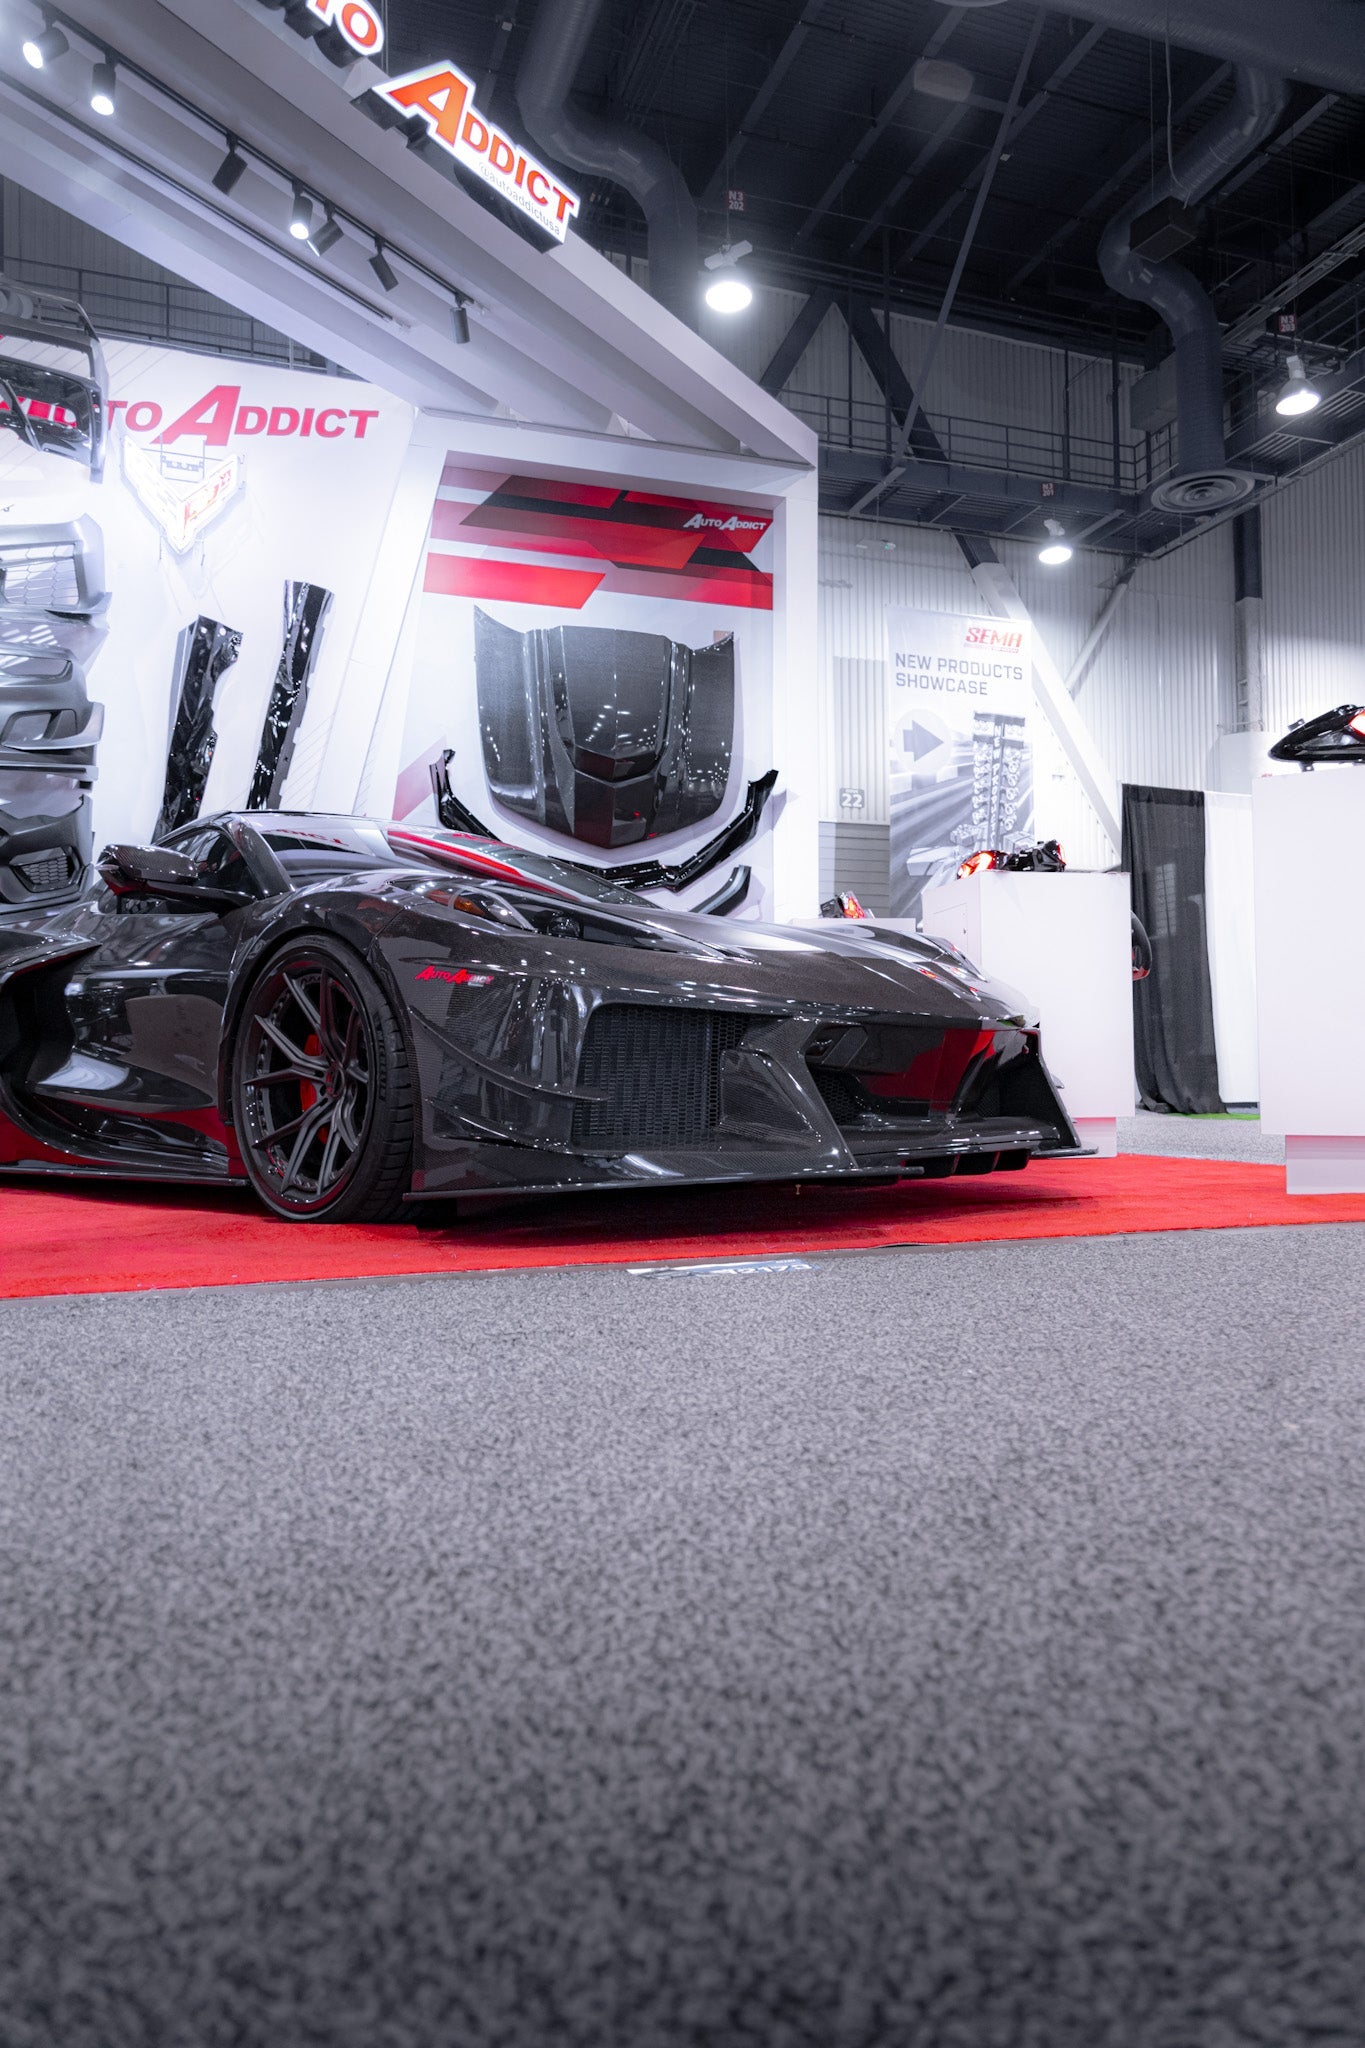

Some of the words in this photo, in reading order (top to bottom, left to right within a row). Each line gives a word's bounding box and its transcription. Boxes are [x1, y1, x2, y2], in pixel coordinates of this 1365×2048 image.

[479, 162, 560, 235] @autoaddictusa
[728, 190, 743, 201] N3
[728, 200, 744, 211] 202
[1280, 315, 1294, 323] N3
[150, 385, 379, 446] ADDICT
[895, 653, 932, 670] NEW
[937, 658, 1023, 680] PRODUCTS
[896, 672, 988, 695] SHOWCASE
[841, 793, 863, 807] 22
